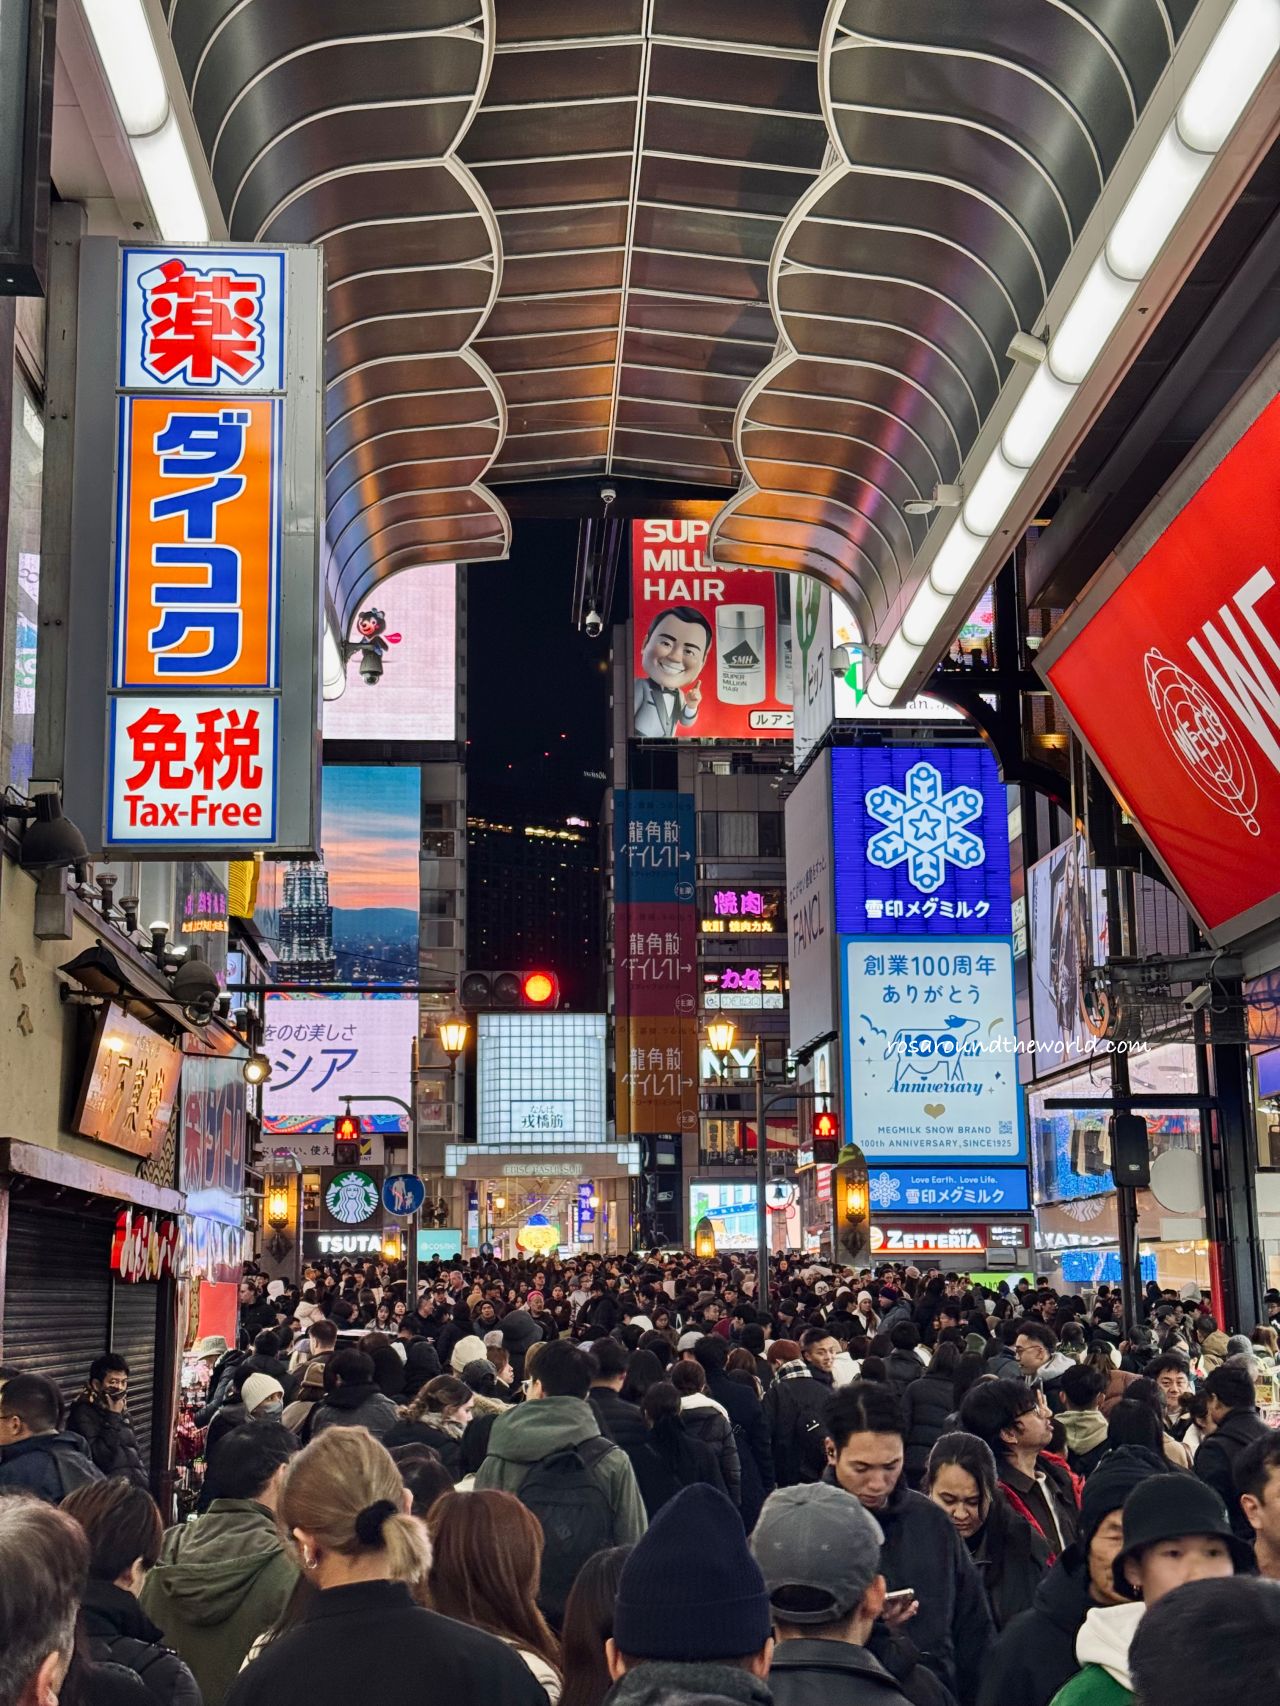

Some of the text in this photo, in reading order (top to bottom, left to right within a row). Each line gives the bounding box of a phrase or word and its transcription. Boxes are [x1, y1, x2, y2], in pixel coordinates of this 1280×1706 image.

[140, 259, 262, 382] 薬
[149, 409, 252, 675] ダイコク
[643, 520, 709, 543] SUP
[643, 549, 766, 572] MILL
[643, 579, 725, 600] HAIR
[731, 655, 753, 665] SMH
[722, 672, 745, 680] SUPER
[125, 707, 263, 792] 免税
[124, 795, 262, 828] Tax-Free
[629, 820, 681, 843] 龍角散
[620, 844, 690, 868] ダイレクト
[714, 891, 764, 914] 焼肉
[865, 897, 990, 918] 雪印メグミルク
[793, 891, 824, 959] FANCL
[629, 932, 682, 955] 龍角散
[620, 958, 692, 980] ダイレクト
[863, 954, 997, 977] 創業100周年
[882, 984, 981, 1005] ありがとう
[265, 1024, 357, 1042] をのむ美しさ
[630, 1047, 683, 1071] 龍角散
[621, 1073, 693, 1096] ダイレクト
[887, 1080, 983, 1096] Anniversary
[520, 1113, 563, 1129] 戎橋筋
[878, 1126, 991, 1134] MEGMILK SNOW BRAND
[861, 1139, 885, 1148] 100th
[911, 1175, 998, 1184] Love Earth. Love Life.
[906, 1186, 1004, 1204] 雪印メグミルク
[318, 1235, 406, 1252] TSUTA
[887, 1230, 982, 1249] ZETTERIA
